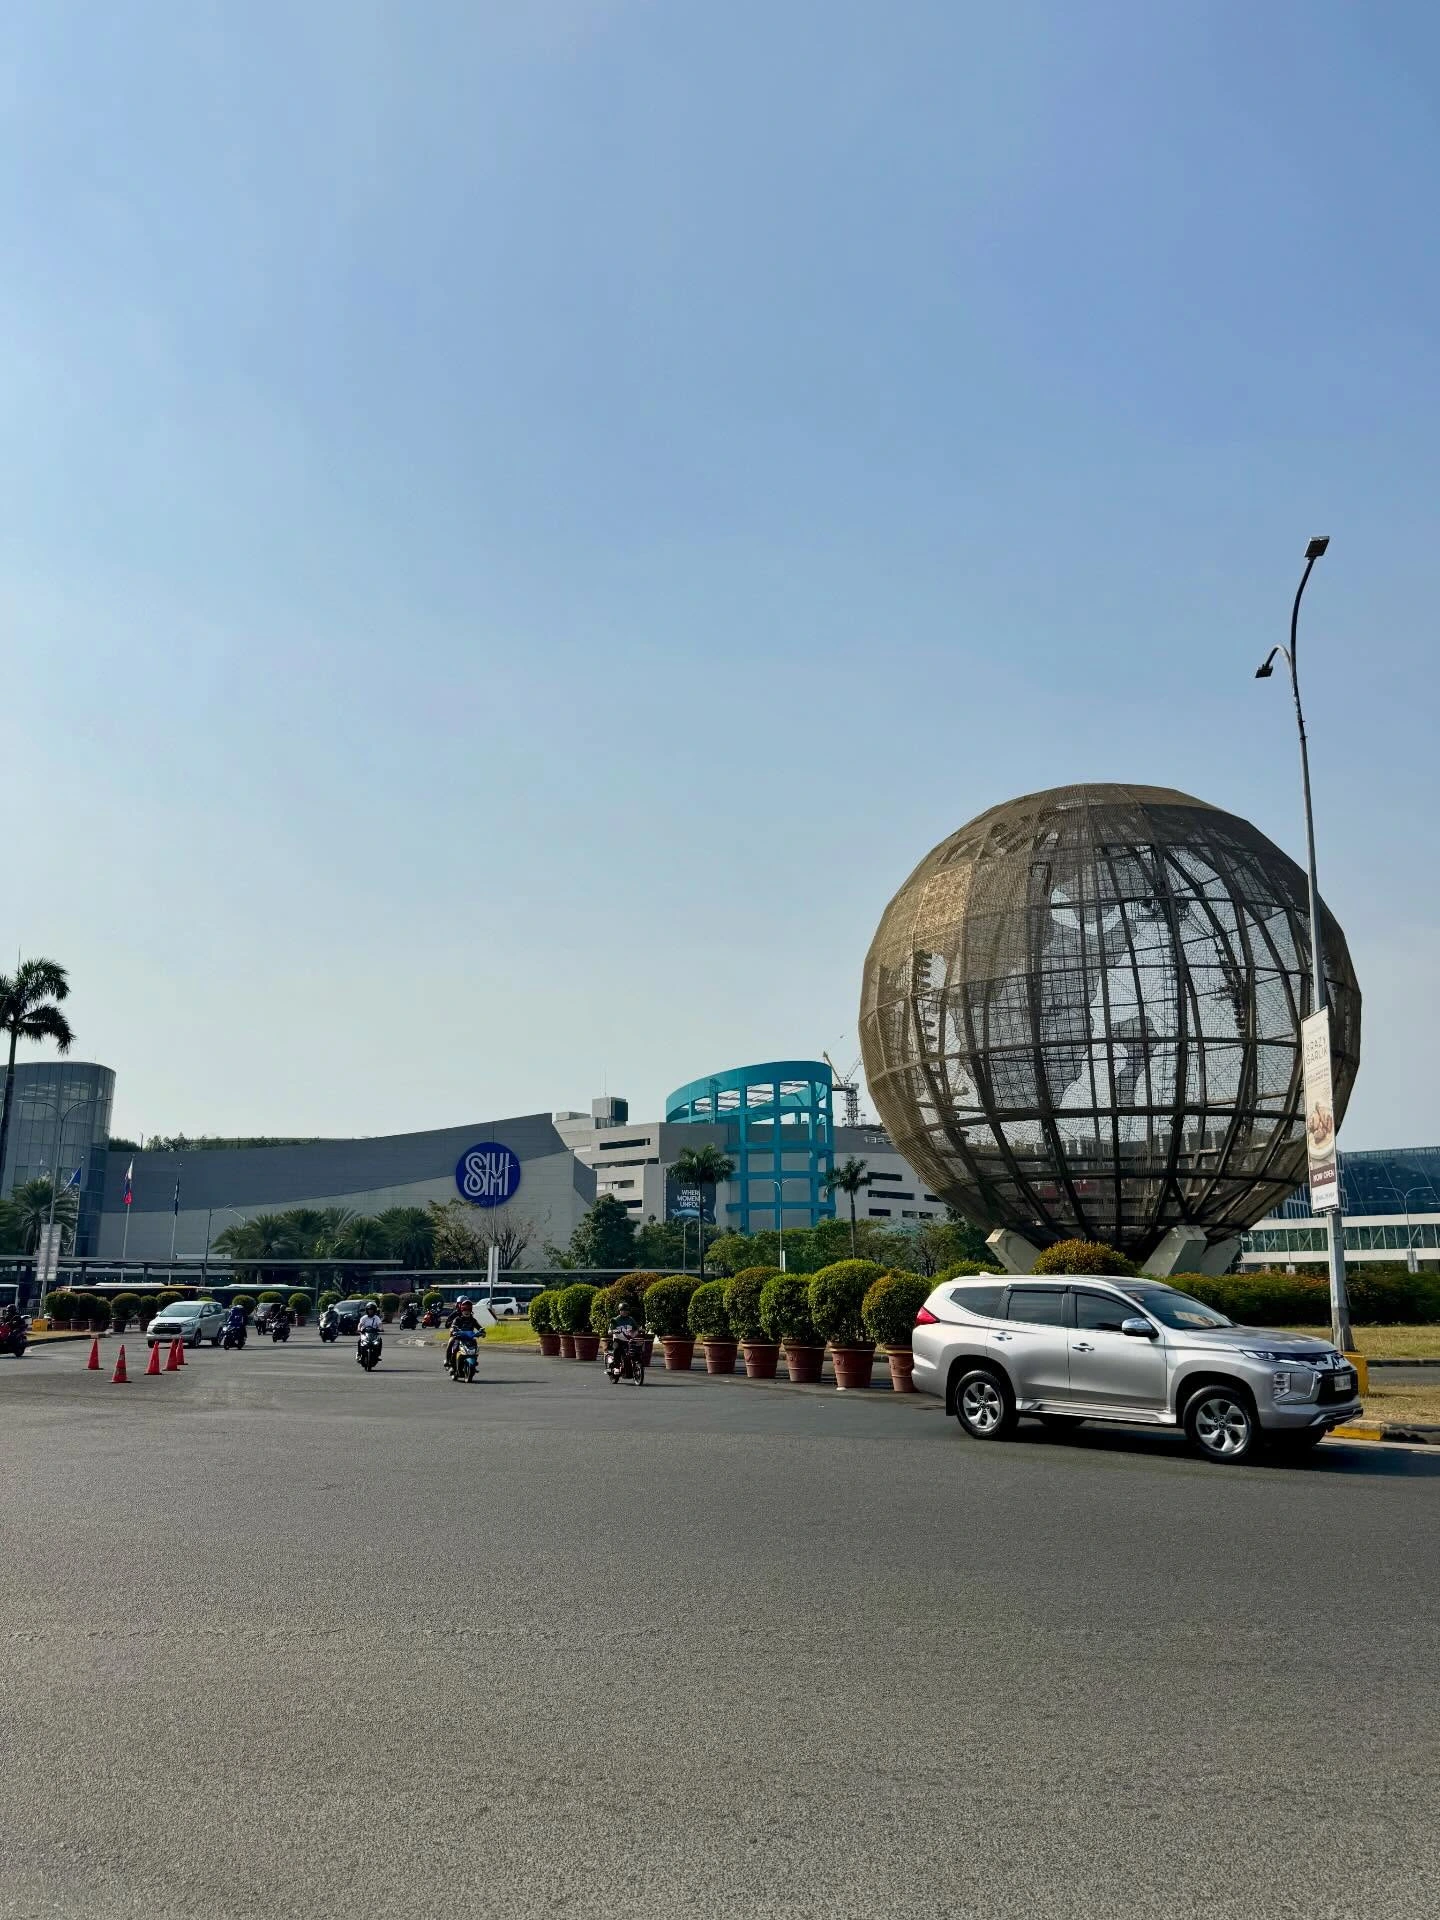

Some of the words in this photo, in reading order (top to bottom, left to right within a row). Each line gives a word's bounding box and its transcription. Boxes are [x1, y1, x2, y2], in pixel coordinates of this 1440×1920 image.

[1306, 1047, 1328, 1065] GARLIK
[463, 1151, 510, 1197] SM
[1313, 1173, 1323, 1182] NOW
[1324, 1169, 1335, 1178] OPEN
